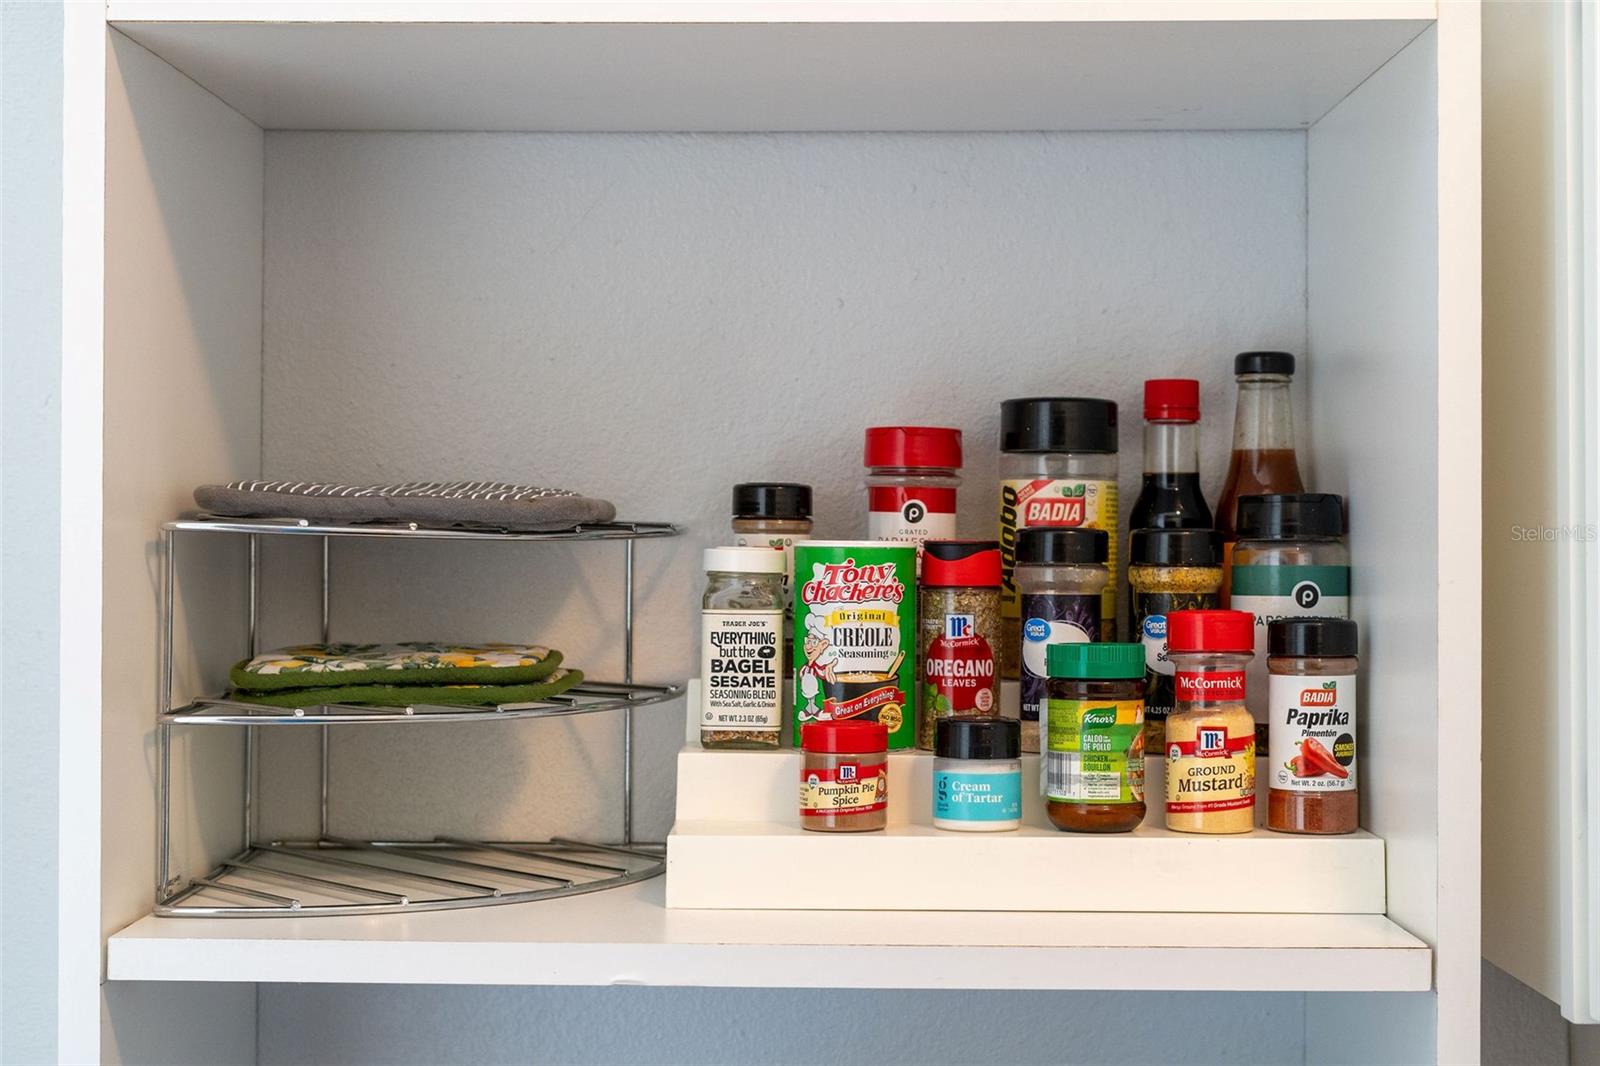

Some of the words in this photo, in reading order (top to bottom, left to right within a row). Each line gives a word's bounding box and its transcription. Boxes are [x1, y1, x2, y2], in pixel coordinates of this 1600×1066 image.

[1028, 503, 1080, 521] BADIA
[824, 559, 894, 585] Tony
[802, 578, 904, 603] Chachere's
[839, 612, 886, 621] Original
[1026, 624, 1045, 632] Great
[1146, 620, 1168, 630] Great
[710, 631, 776, 646] EVERYTHING
[940, 638, 979, 648] McCormick
[719, 645, 737, 658] but
[738, 645, 756, 658] the
[838, 649, 889, 659] Seasoning
[711, 659, 775, 674] BAGEL
[926, 658, 994, 677] OREGANO
[710, 676, 776, 688] SESAME
[942, 678, 976, 688] LEAVES
[1180, 676, 1242, 689] McCormick
[710, 689, 752, 700] SEASONING
[752, 690, 776, 700] BLEND
[1302, 692, 1334, 703] BADIA
[835, 704, 854, 716] Great
[854, 702, 863, 710] on
[863, 689, 896, 707] Everything!
[1084, 713, 1114, 724] Knorr
[1286, 708, 1350, 730] Paprika
[1084, 734, 1102, 743] CALDO
[1302, 729, 1338, 738] Pimentón
[1084, 743, 1091, 751] DE
[1092, 743, 1112, 751] POLLO
[1084, 754, 1108, 762] CHICKEN
[1084, 763, 1111, 772] BOUILLON
[1188, 764, 1236, 777] GROUND
[952, 781, 991, 792] Cream
[1178, 773, 1243, 793] Mustard
[818, 784, 860, 797] Pumpkin
[862, 782, 875, 792] Pie
[832, 796, 859, 807] Spice
[952, 792, 966, 803] of
[966, 792, 1004, 803] Tartar
